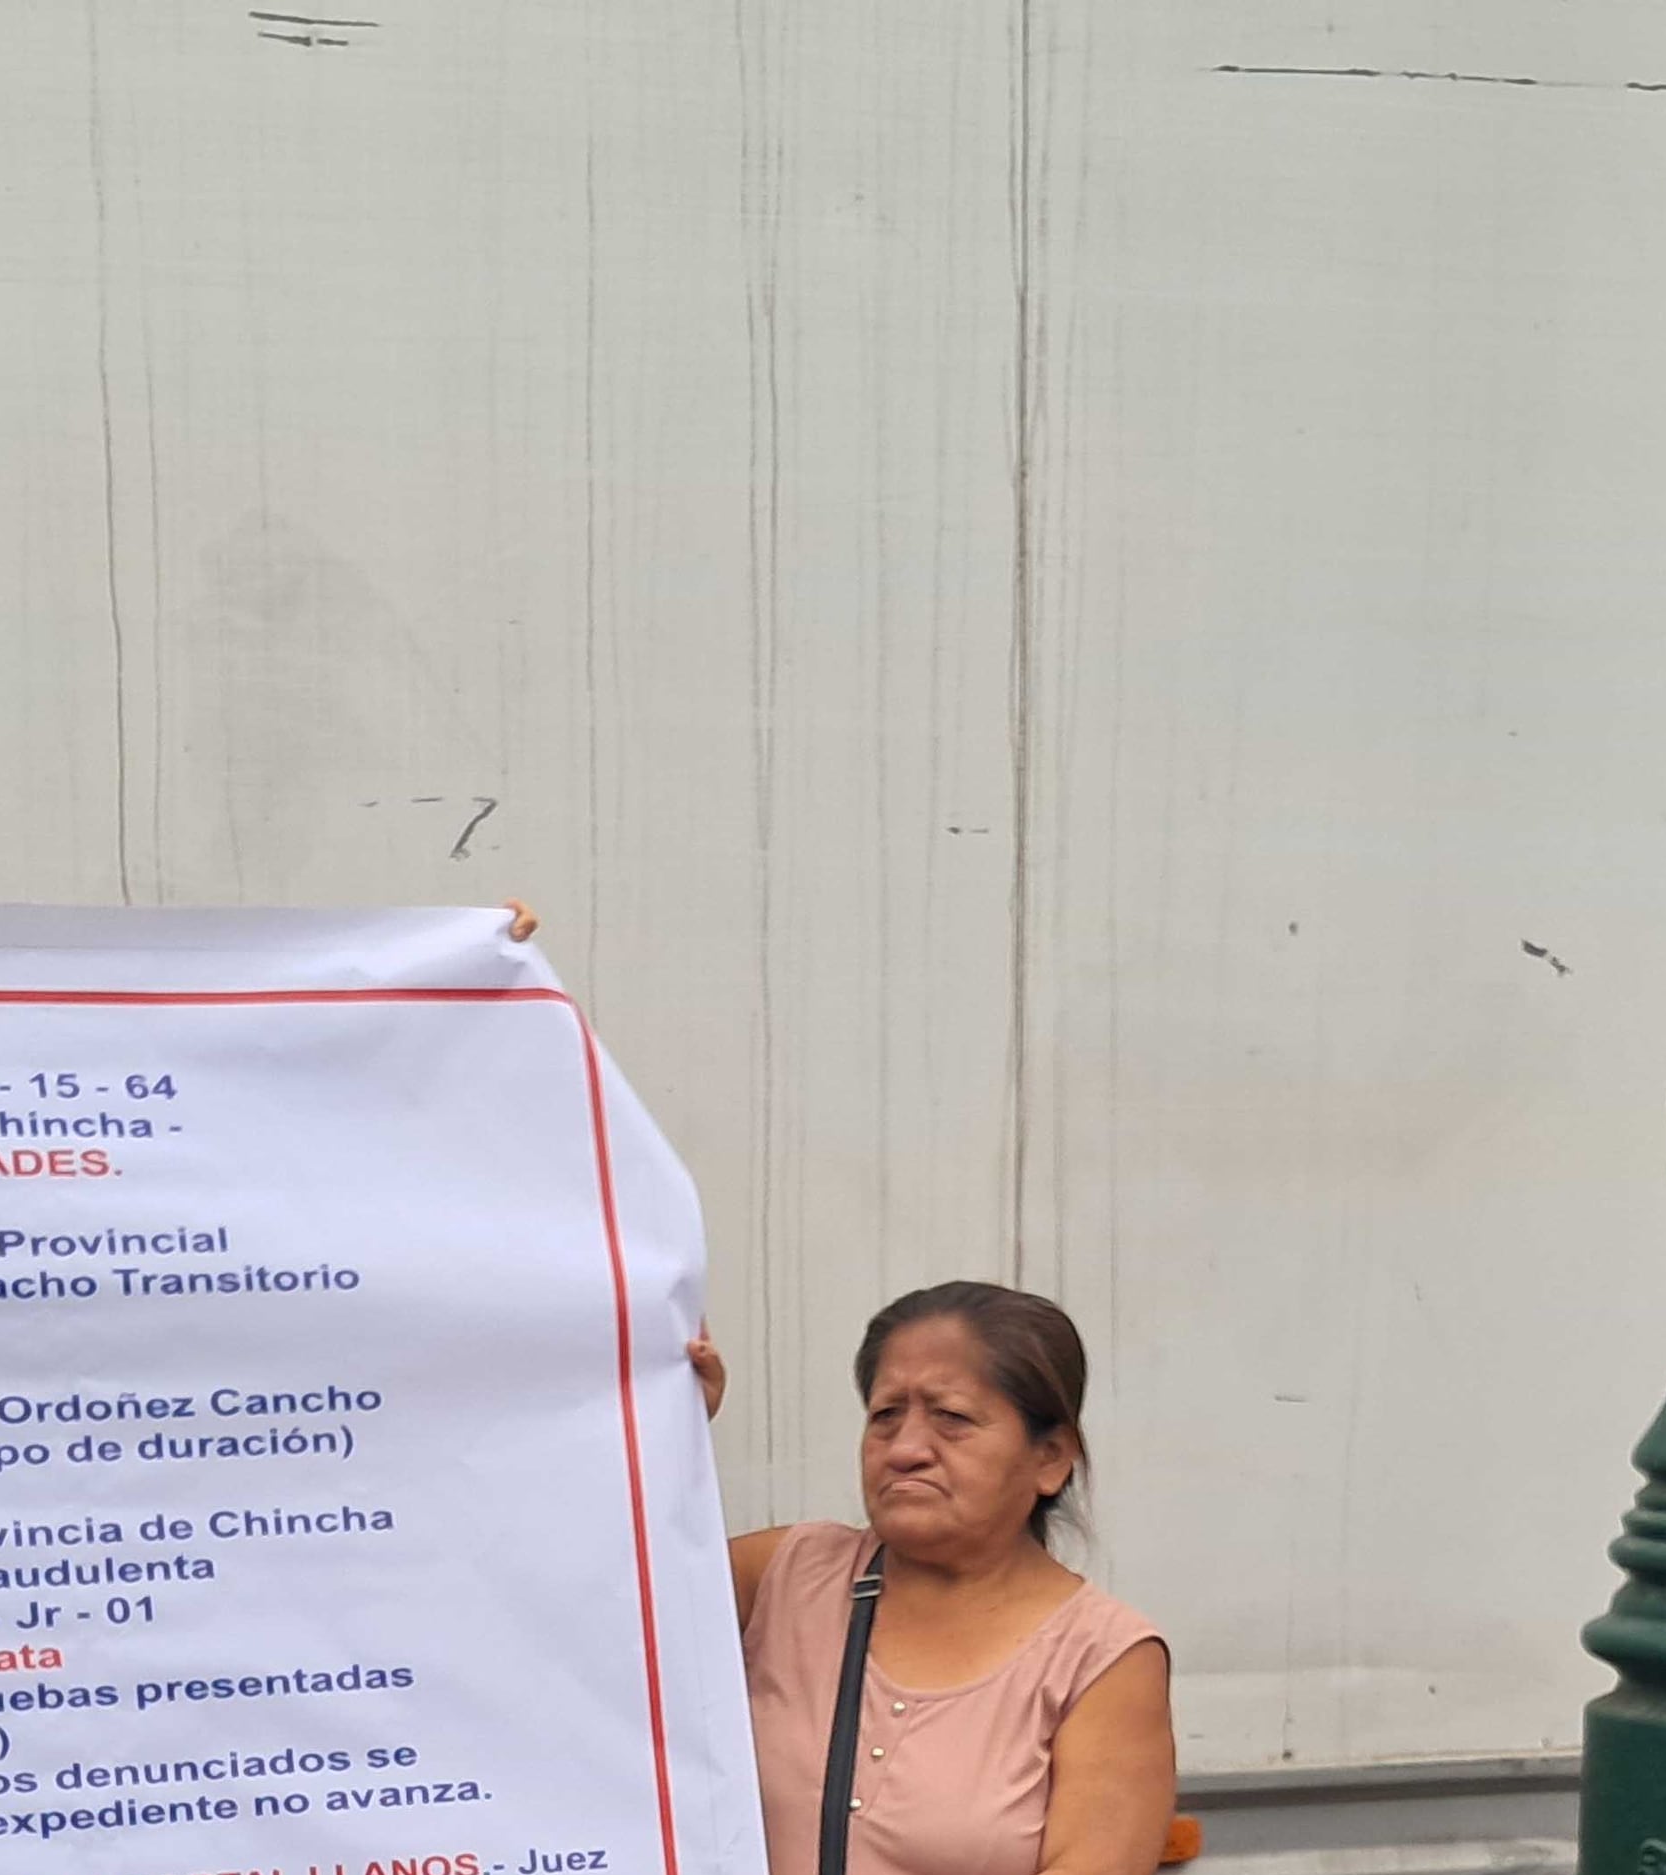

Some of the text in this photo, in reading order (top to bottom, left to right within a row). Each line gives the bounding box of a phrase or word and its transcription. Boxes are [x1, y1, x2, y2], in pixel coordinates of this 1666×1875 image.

[28, 1072, 81, 1099] 15
[124, 1074, 178, 1100] 64
[111, 1263, 360, 1297] Transitorio
[210, 1385, 382, 1417] Cancho
[66, 1434, 123, 1463] de
[137, 1424, 354, 1461] duración)
[254, 1793, 310, 1817] no
[326, 1781, 493, 1812] avanza.
[518, 1848, 609, 1875] Juez
